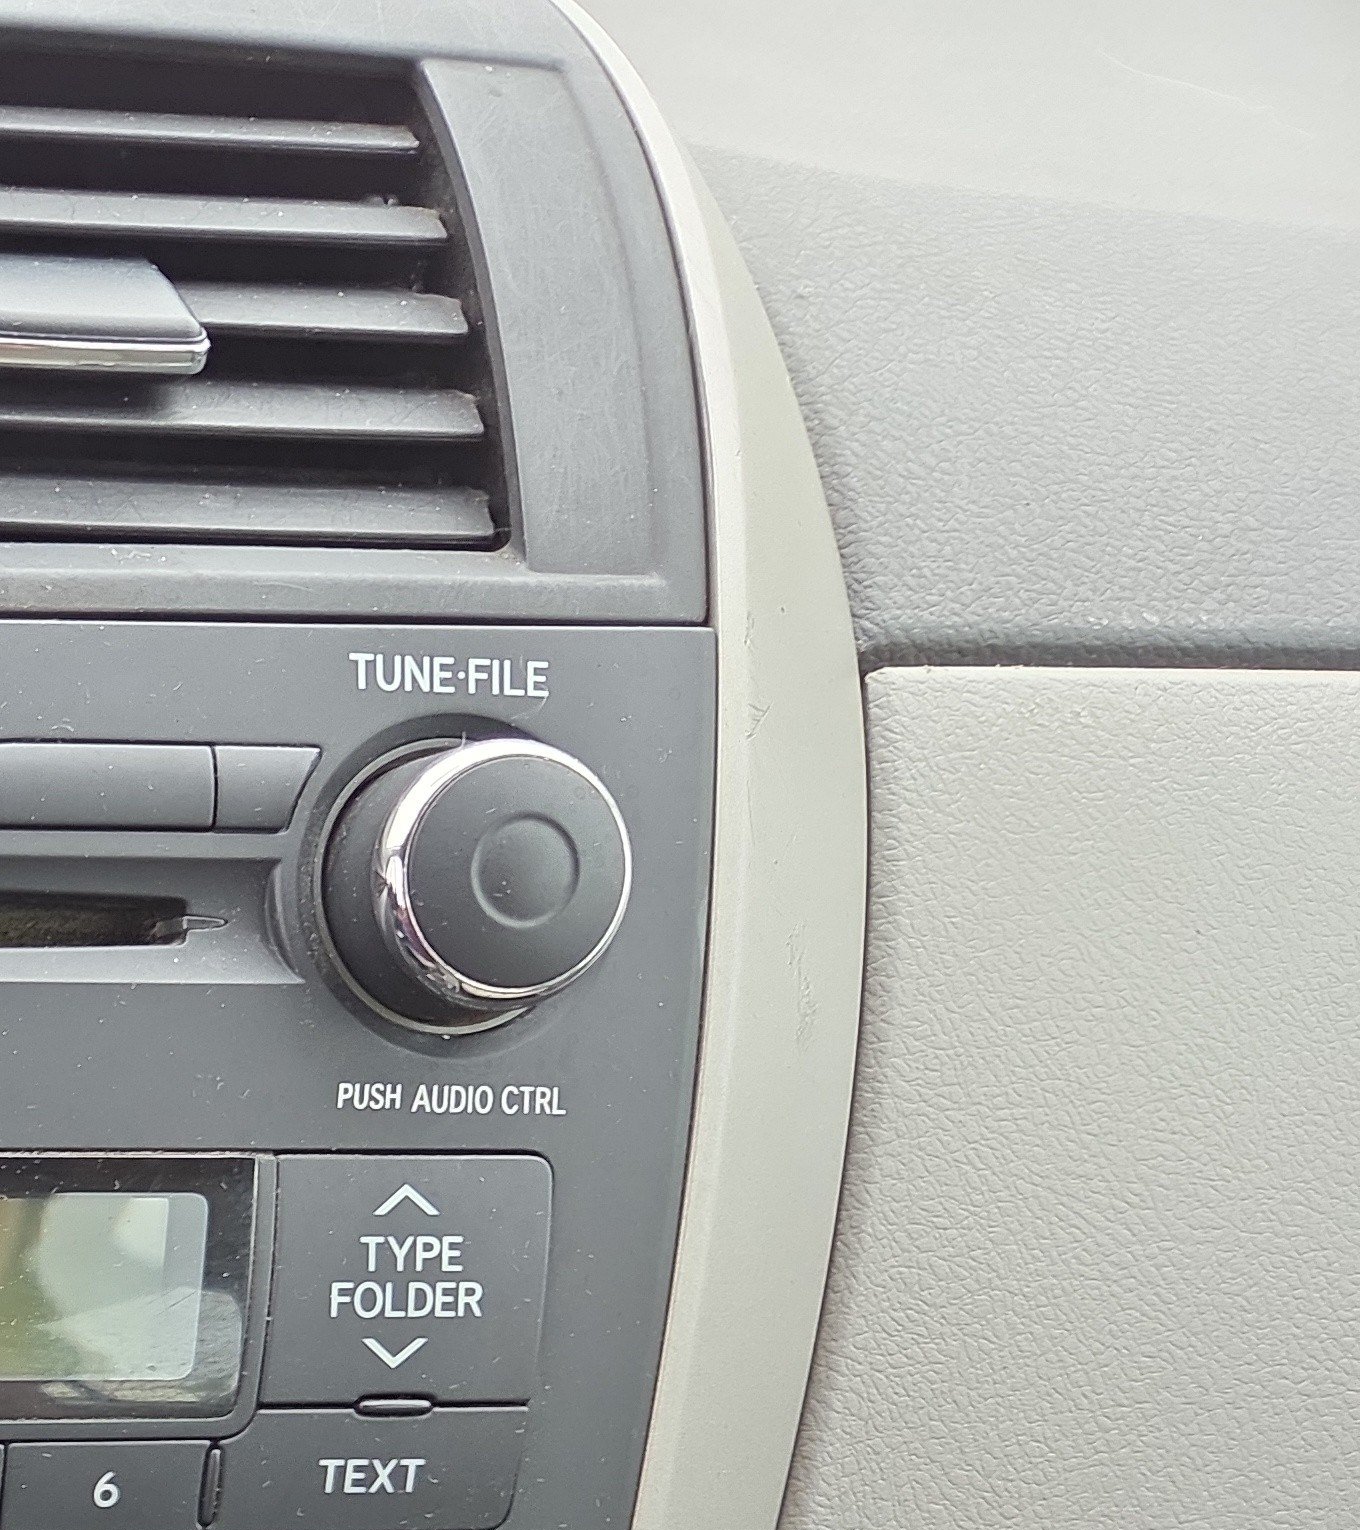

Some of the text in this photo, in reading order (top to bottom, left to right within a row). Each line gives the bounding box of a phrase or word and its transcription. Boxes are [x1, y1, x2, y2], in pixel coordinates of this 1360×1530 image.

[336, 1082, 568, 1116] PUSH AUDIO CTRL
[359, 1235, 465, 1273] TYPE
[329, 1281, 484, 1319] FOLDER
[92, 1471, 120, 1508] 6
[318, 1458, 426, 1495] TEXT
